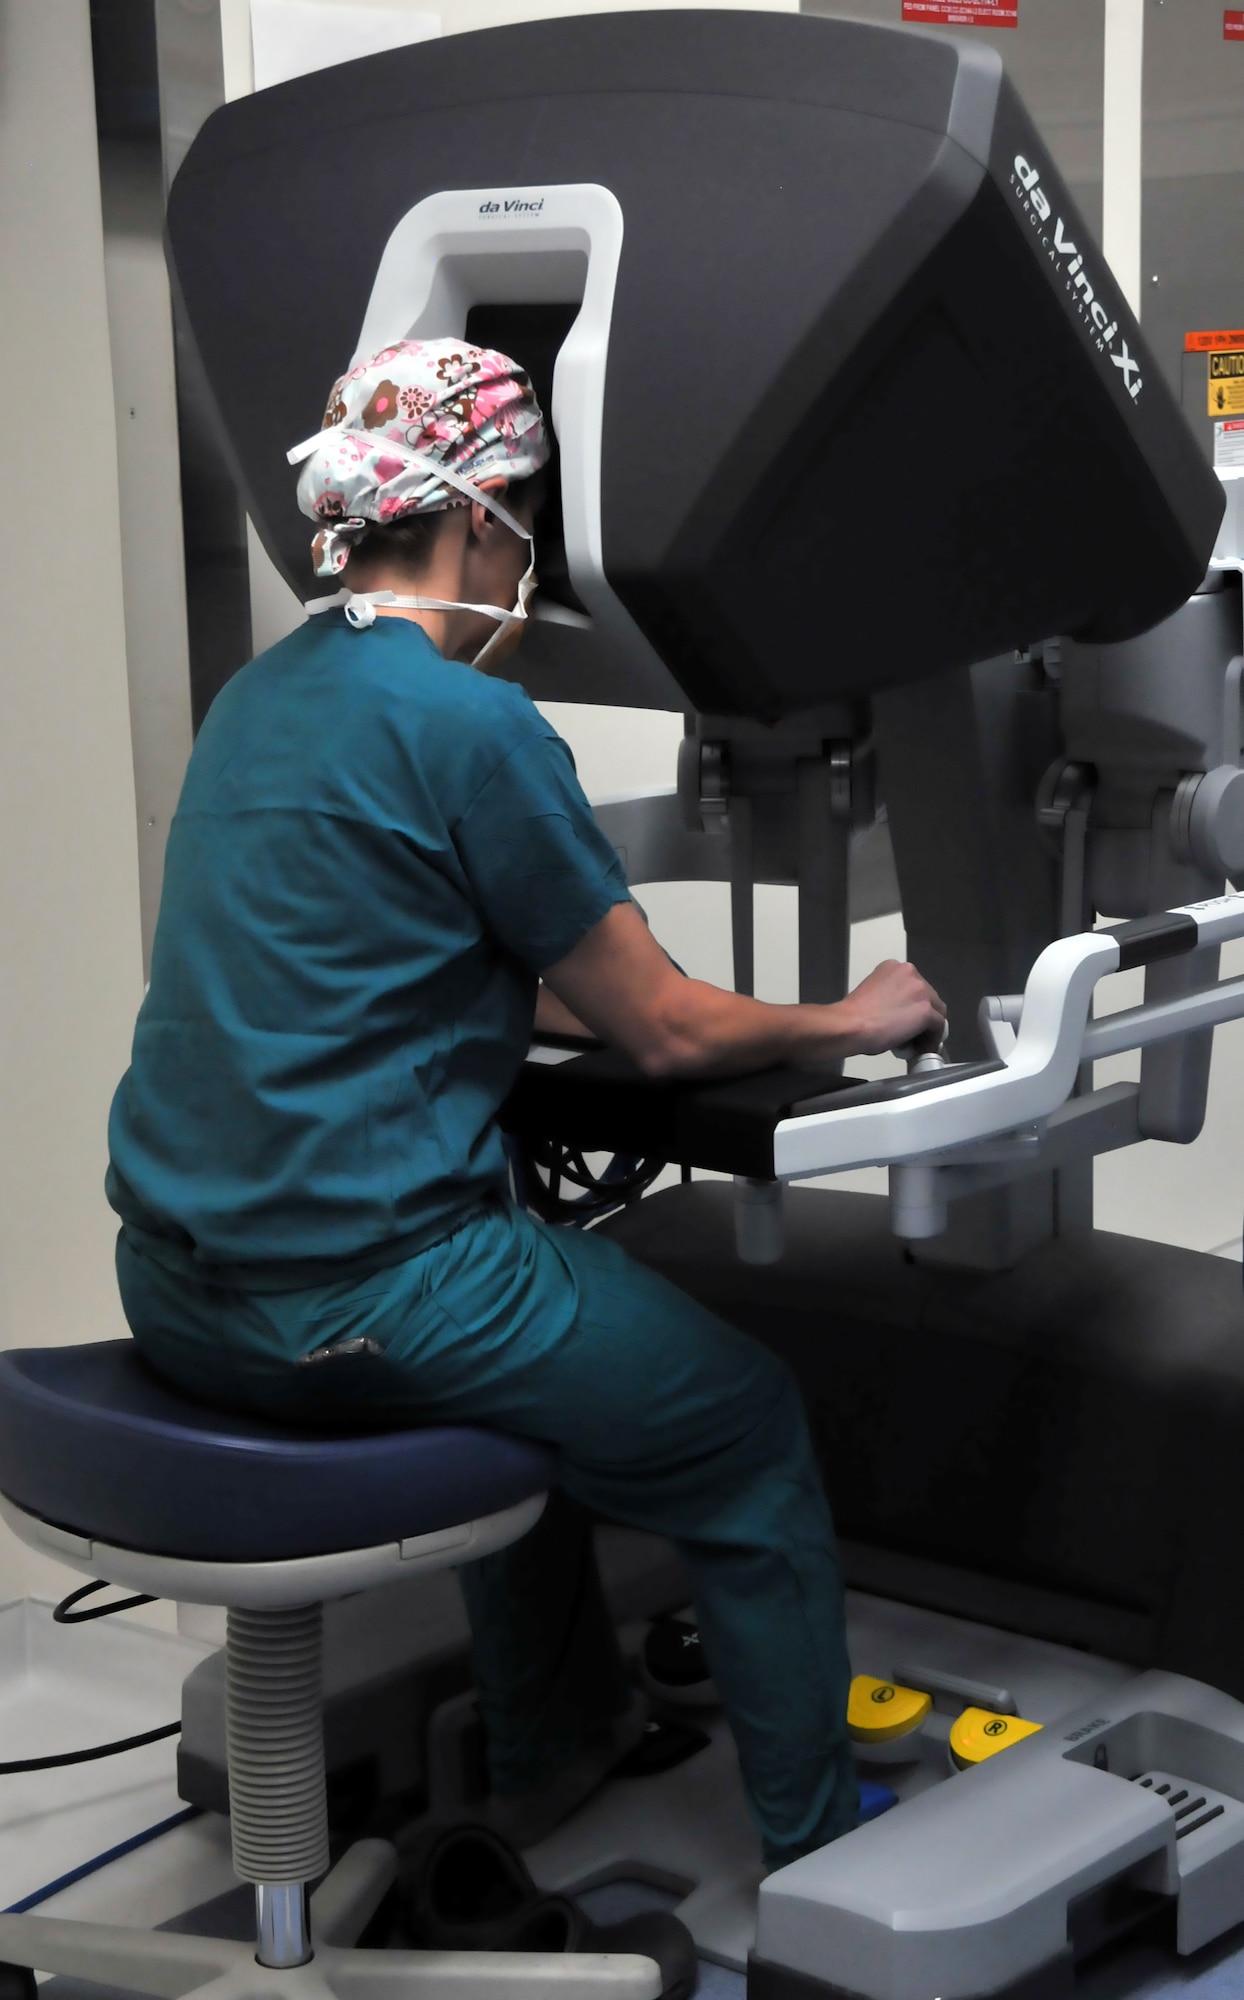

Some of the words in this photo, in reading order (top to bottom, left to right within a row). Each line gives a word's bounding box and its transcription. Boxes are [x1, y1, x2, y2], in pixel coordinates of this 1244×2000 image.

[479, 201, 501, 213] da
[504, 198, 544, 212] Vinci
[1009, 173, 1062, 272] SURGICAL
[1065, 280, 1105, 352] SYSTEM
[1014, 155, 1051, 222] da
[1053, 217, 1118, 343] Vinci
[1110, 339, 1143, 399] Xi
[1063, 1718, 1111, 1742] BRAKE
